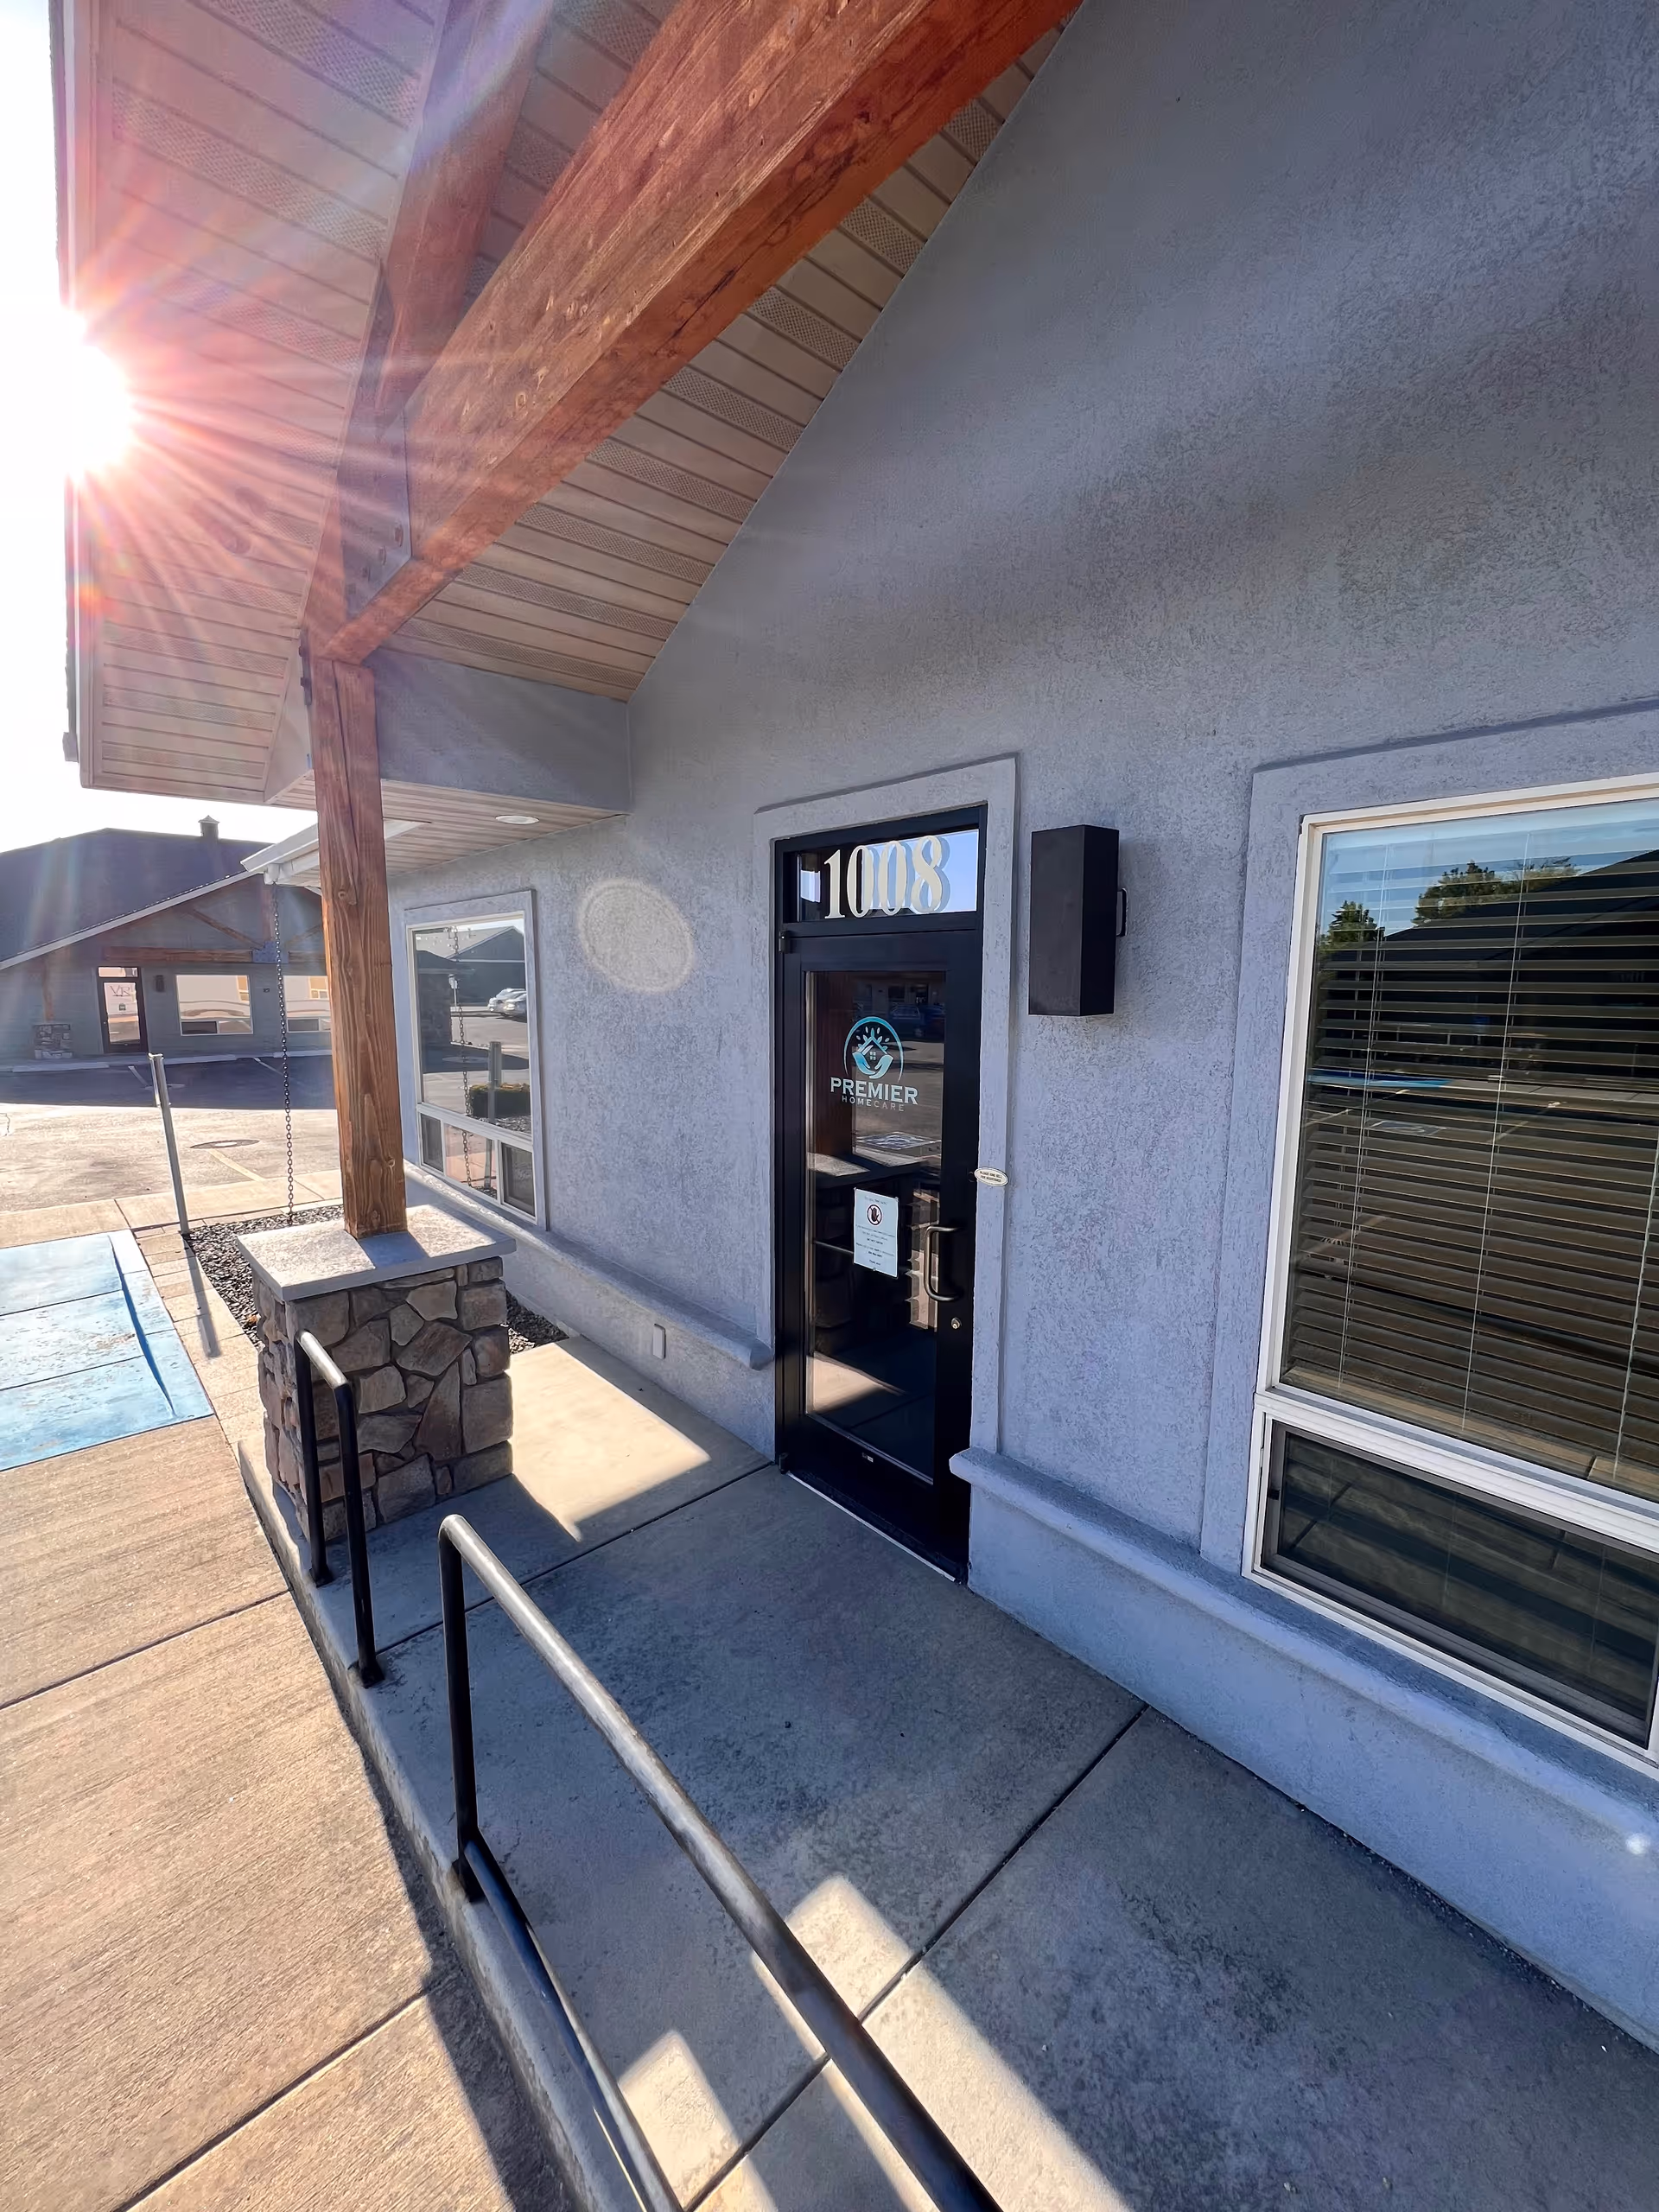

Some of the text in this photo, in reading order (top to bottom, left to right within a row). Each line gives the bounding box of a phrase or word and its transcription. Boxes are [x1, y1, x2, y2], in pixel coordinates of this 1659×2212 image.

[823, 835, 943, 919] 1008
[830, 1077, 918, 1105] PREMIER
[842, 1095, 905, 1112] HOMECARE
